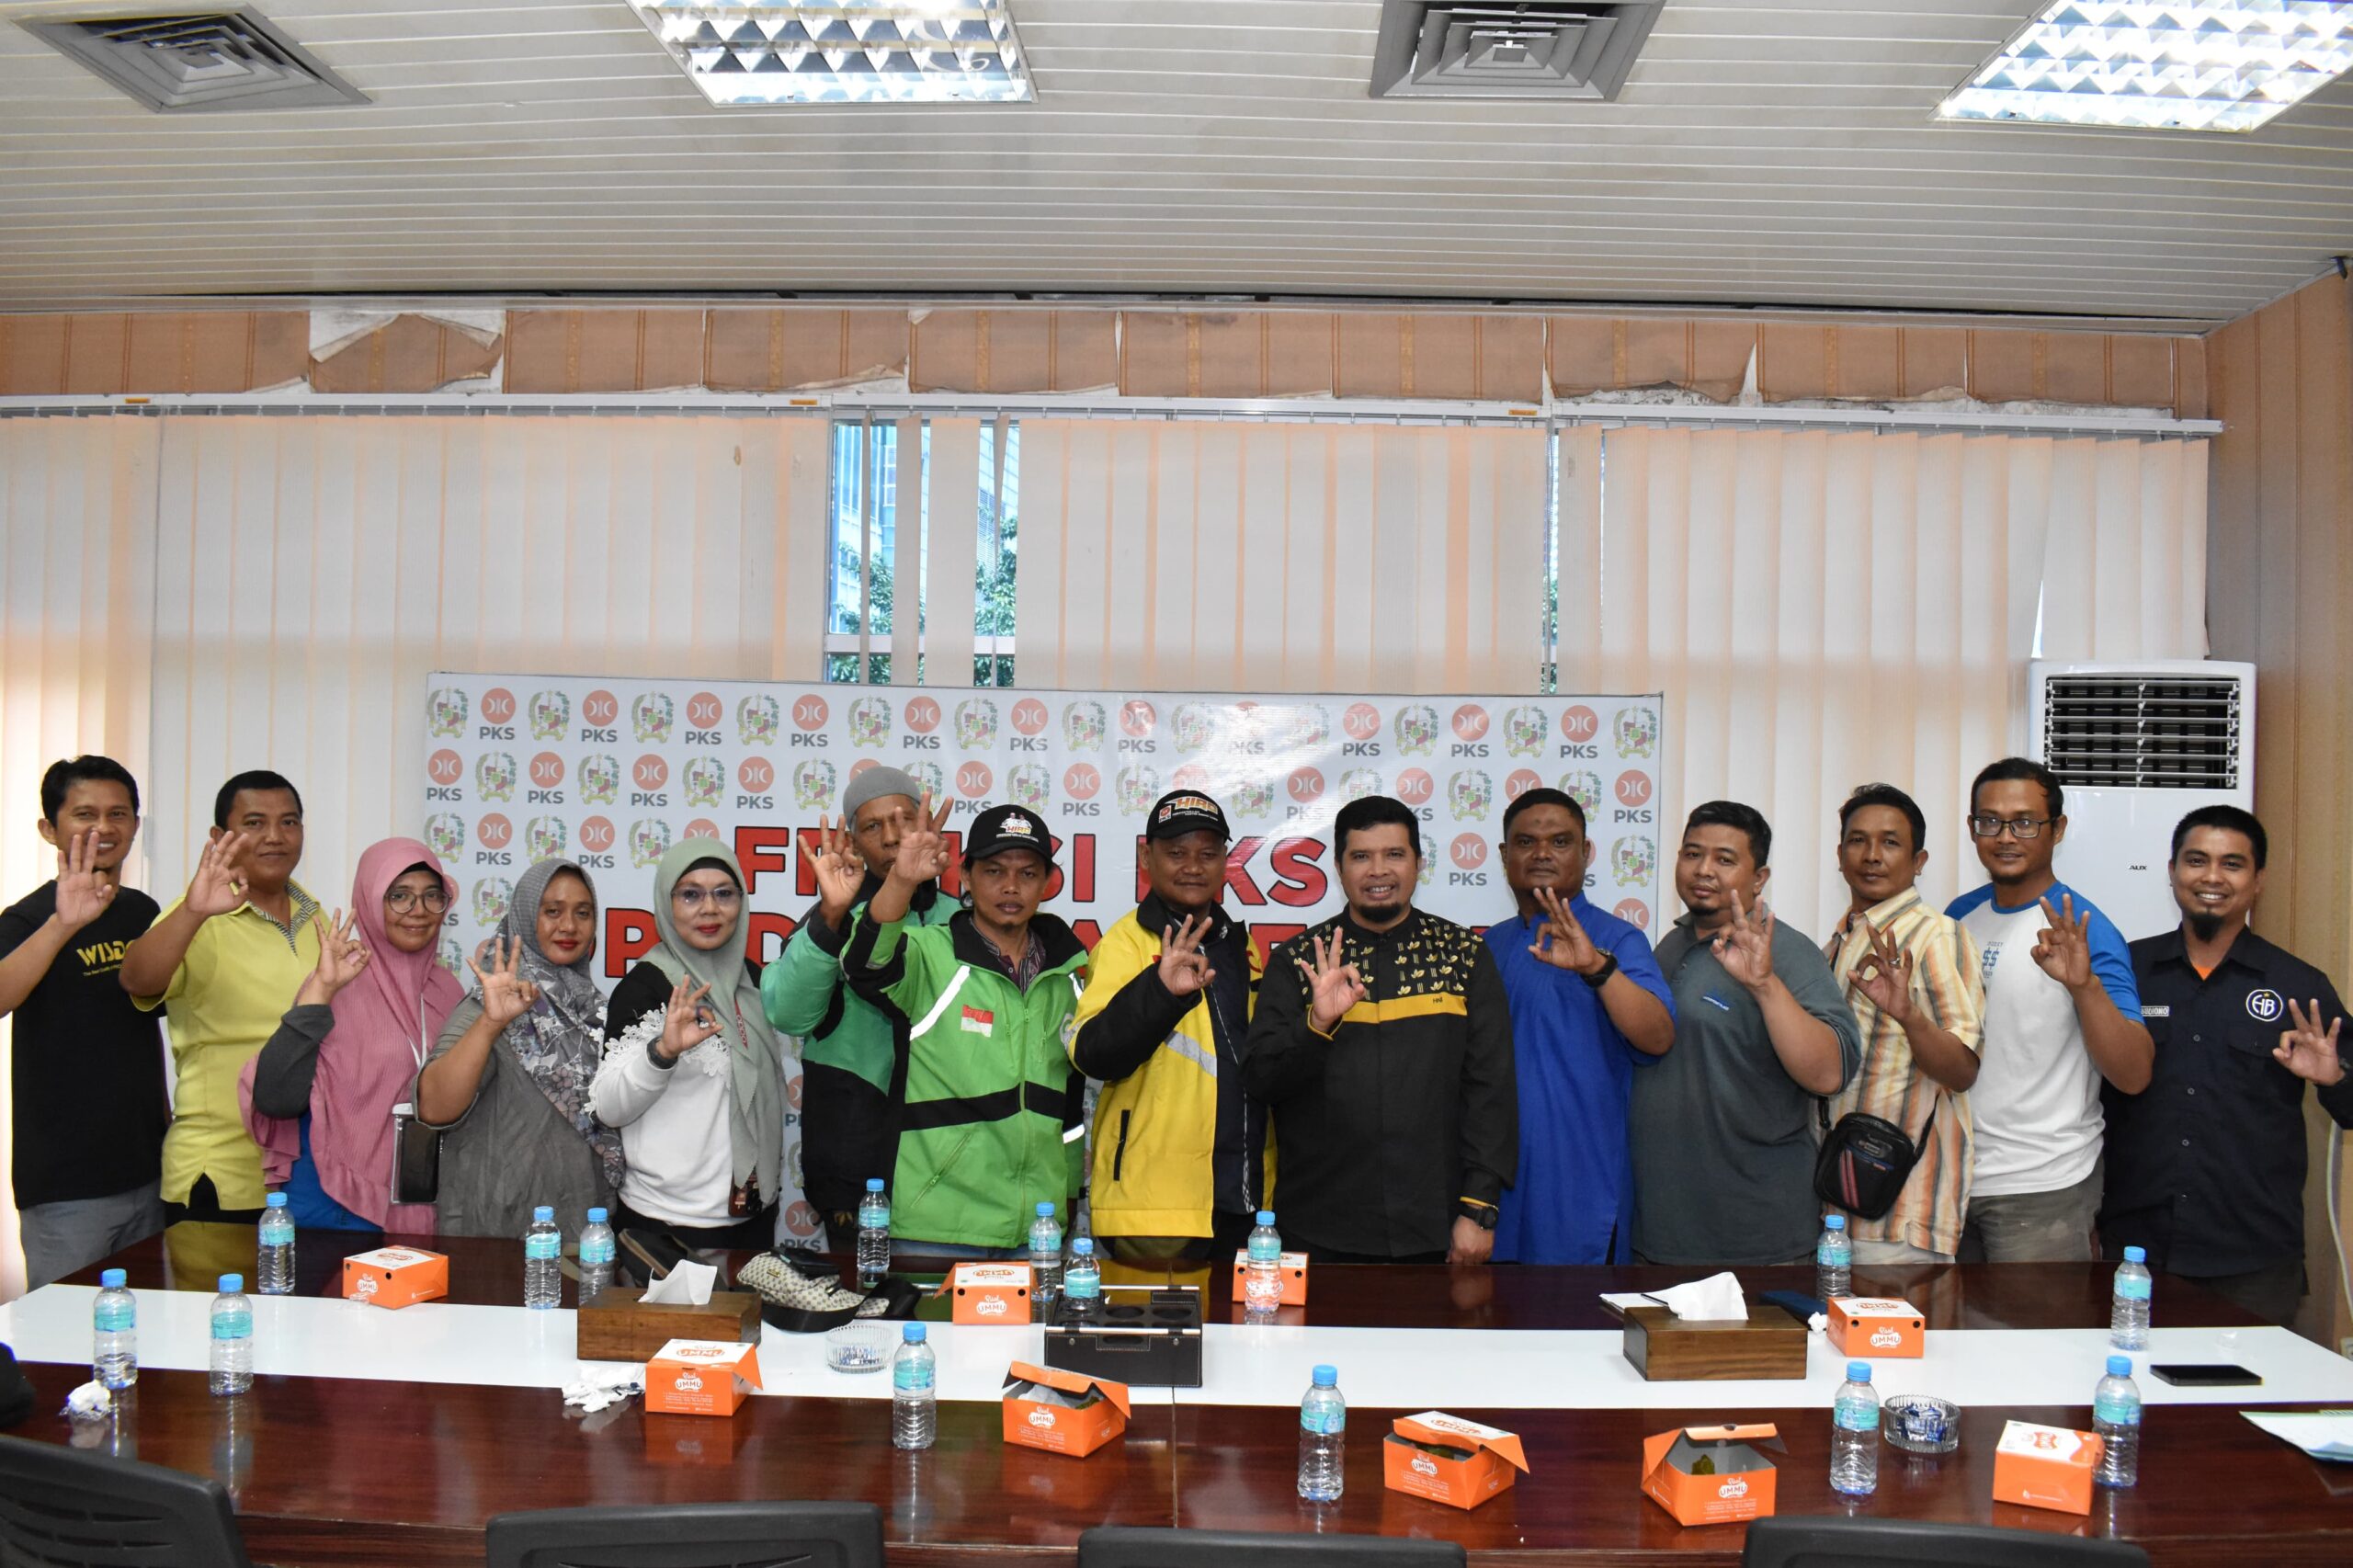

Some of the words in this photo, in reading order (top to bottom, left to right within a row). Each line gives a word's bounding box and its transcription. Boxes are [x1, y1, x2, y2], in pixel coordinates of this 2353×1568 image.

[479, 726, 515, 740] PKS
[581, 729, 618, 743] PKS
[685, 731, 722, 745] PKS
[791, 733, 828, 747] PKS
[904, 735, 940, 750] PKS
[1010, 737, 1048, 752] PKS
[1118, 739, 1156, 754] PKS
[1342, 743, 1381, 756] PKS
[1451, 744, 1489, 757] PKS
[1560, 744, 1598, 758] PKS
[426, 788, 462, 801] PKS
[528, 790, 564, 804] PKS
[631, 793, 668, 807] PKS
[736, 795, 774, 810] PKS
[1063, 802, 1100, 816] PKS
[1614, 809, 1652, 824] PKS
[476, 852, 512, 866] PKS
[578, 854, 615, 869] PKS
[1135, 834, 1328, 908] KS
[1449, 872, 1487, 886] PKS
[76, 940, 137, 967] WISD
[977, 1303, 1006, 1312] UMMU
[1870, 1335, 1900, 1345] UMMU
[676, 1381, 703, 1389] UMMU
[1029, 1415, 1055, 1425] UMMU
[1412, 1460, 1437, 1473] UMMU
[1720, 1483, 1747, 1496] UMMU
